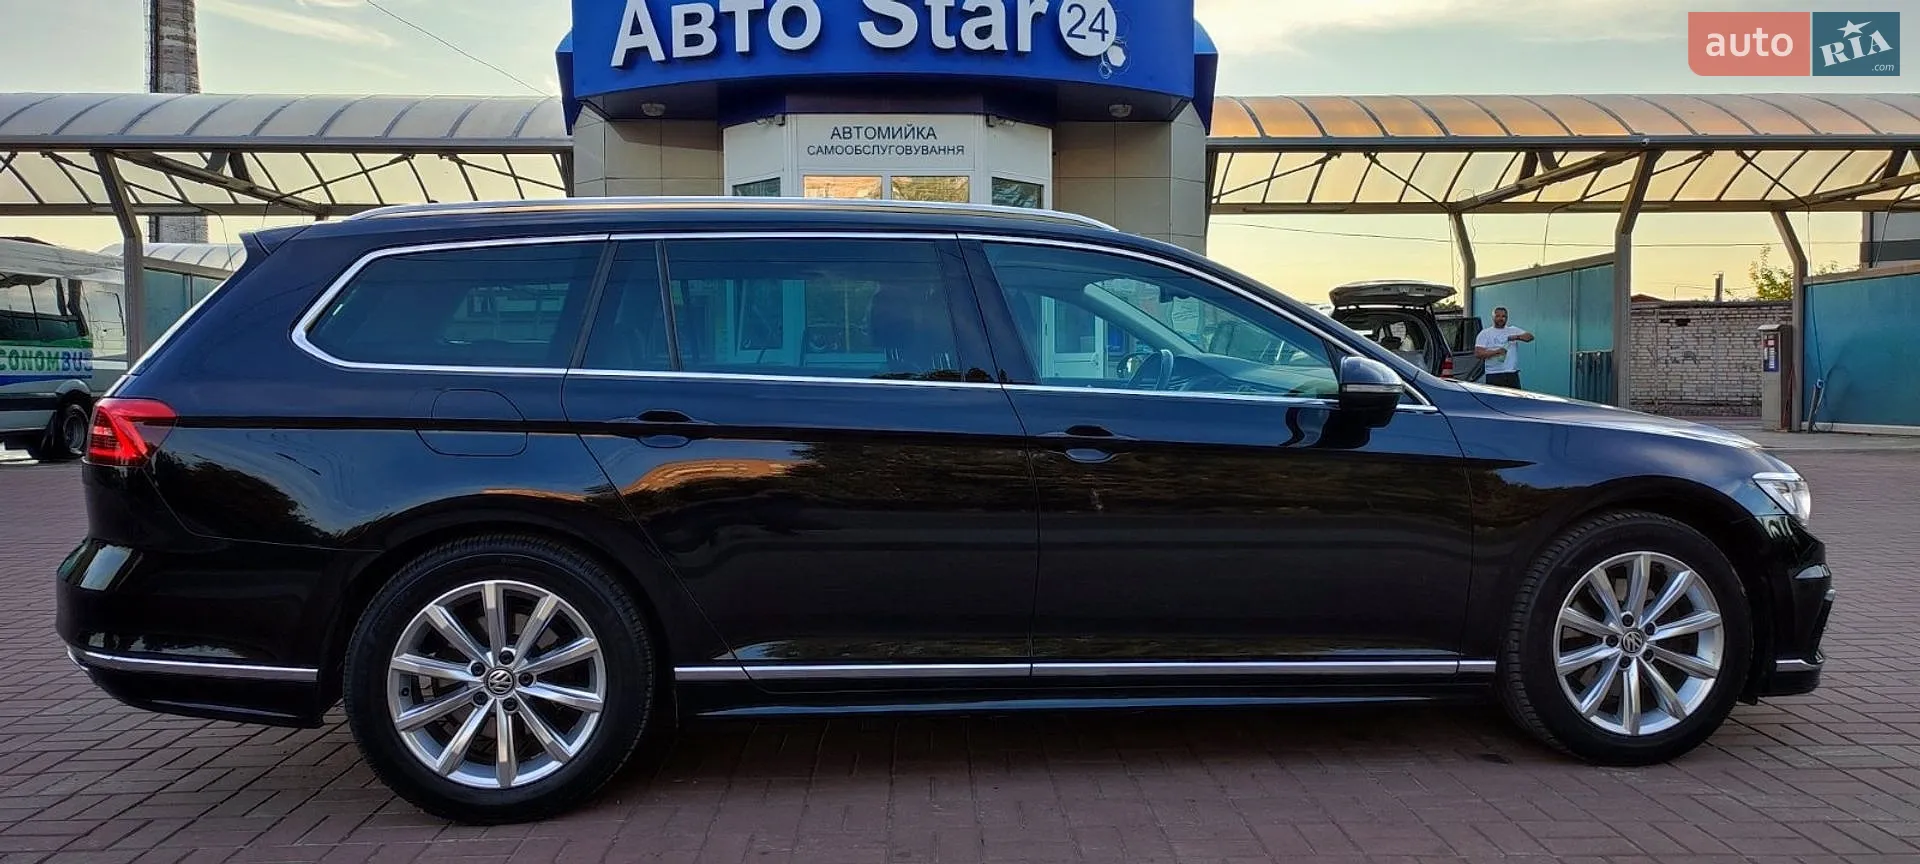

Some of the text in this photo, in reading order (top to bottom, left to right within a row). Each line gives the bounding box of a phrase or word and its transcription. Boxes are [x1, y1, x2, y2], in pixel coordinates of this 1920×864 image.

[858, 0, 1050, 52] Star
[1066, 3, 1110, 42] 24
[830, 124, 937, 140] АВТОМИЙКА
[807, 144, 965, 156] САМООБСЛУГОВУВАННЯ
